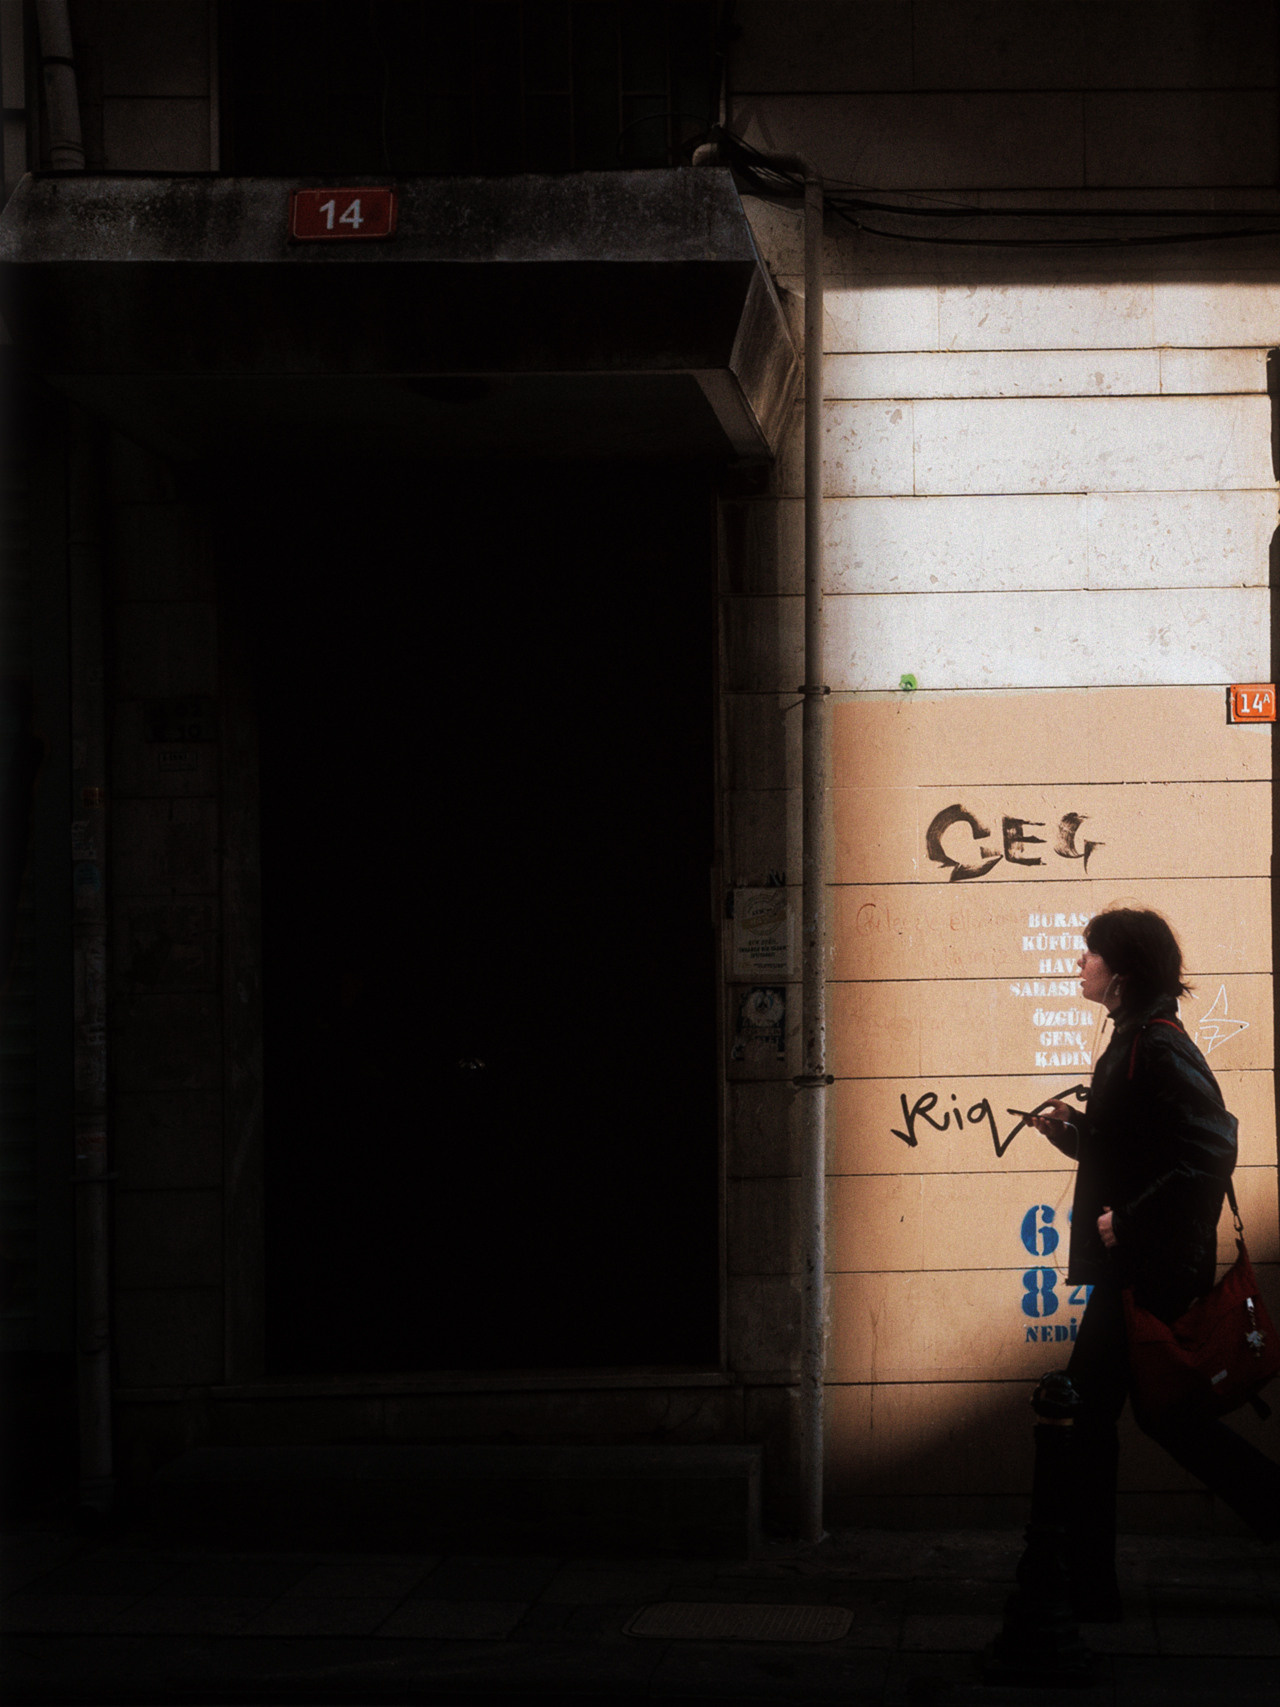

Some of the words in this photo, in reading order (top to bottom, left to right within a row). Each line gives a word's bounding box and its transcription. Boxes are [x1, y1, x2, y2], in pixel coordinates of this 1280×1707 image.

[319, 198, 364, 230] 14
[1033, 1008, 1094, 1027] ÖZGÜR
[1039, 1031, 1088, 1050] GENÇ
[1034, 1051, 1093, 1067] KADIN
[1021, 1205, 1073, 1256] 6
